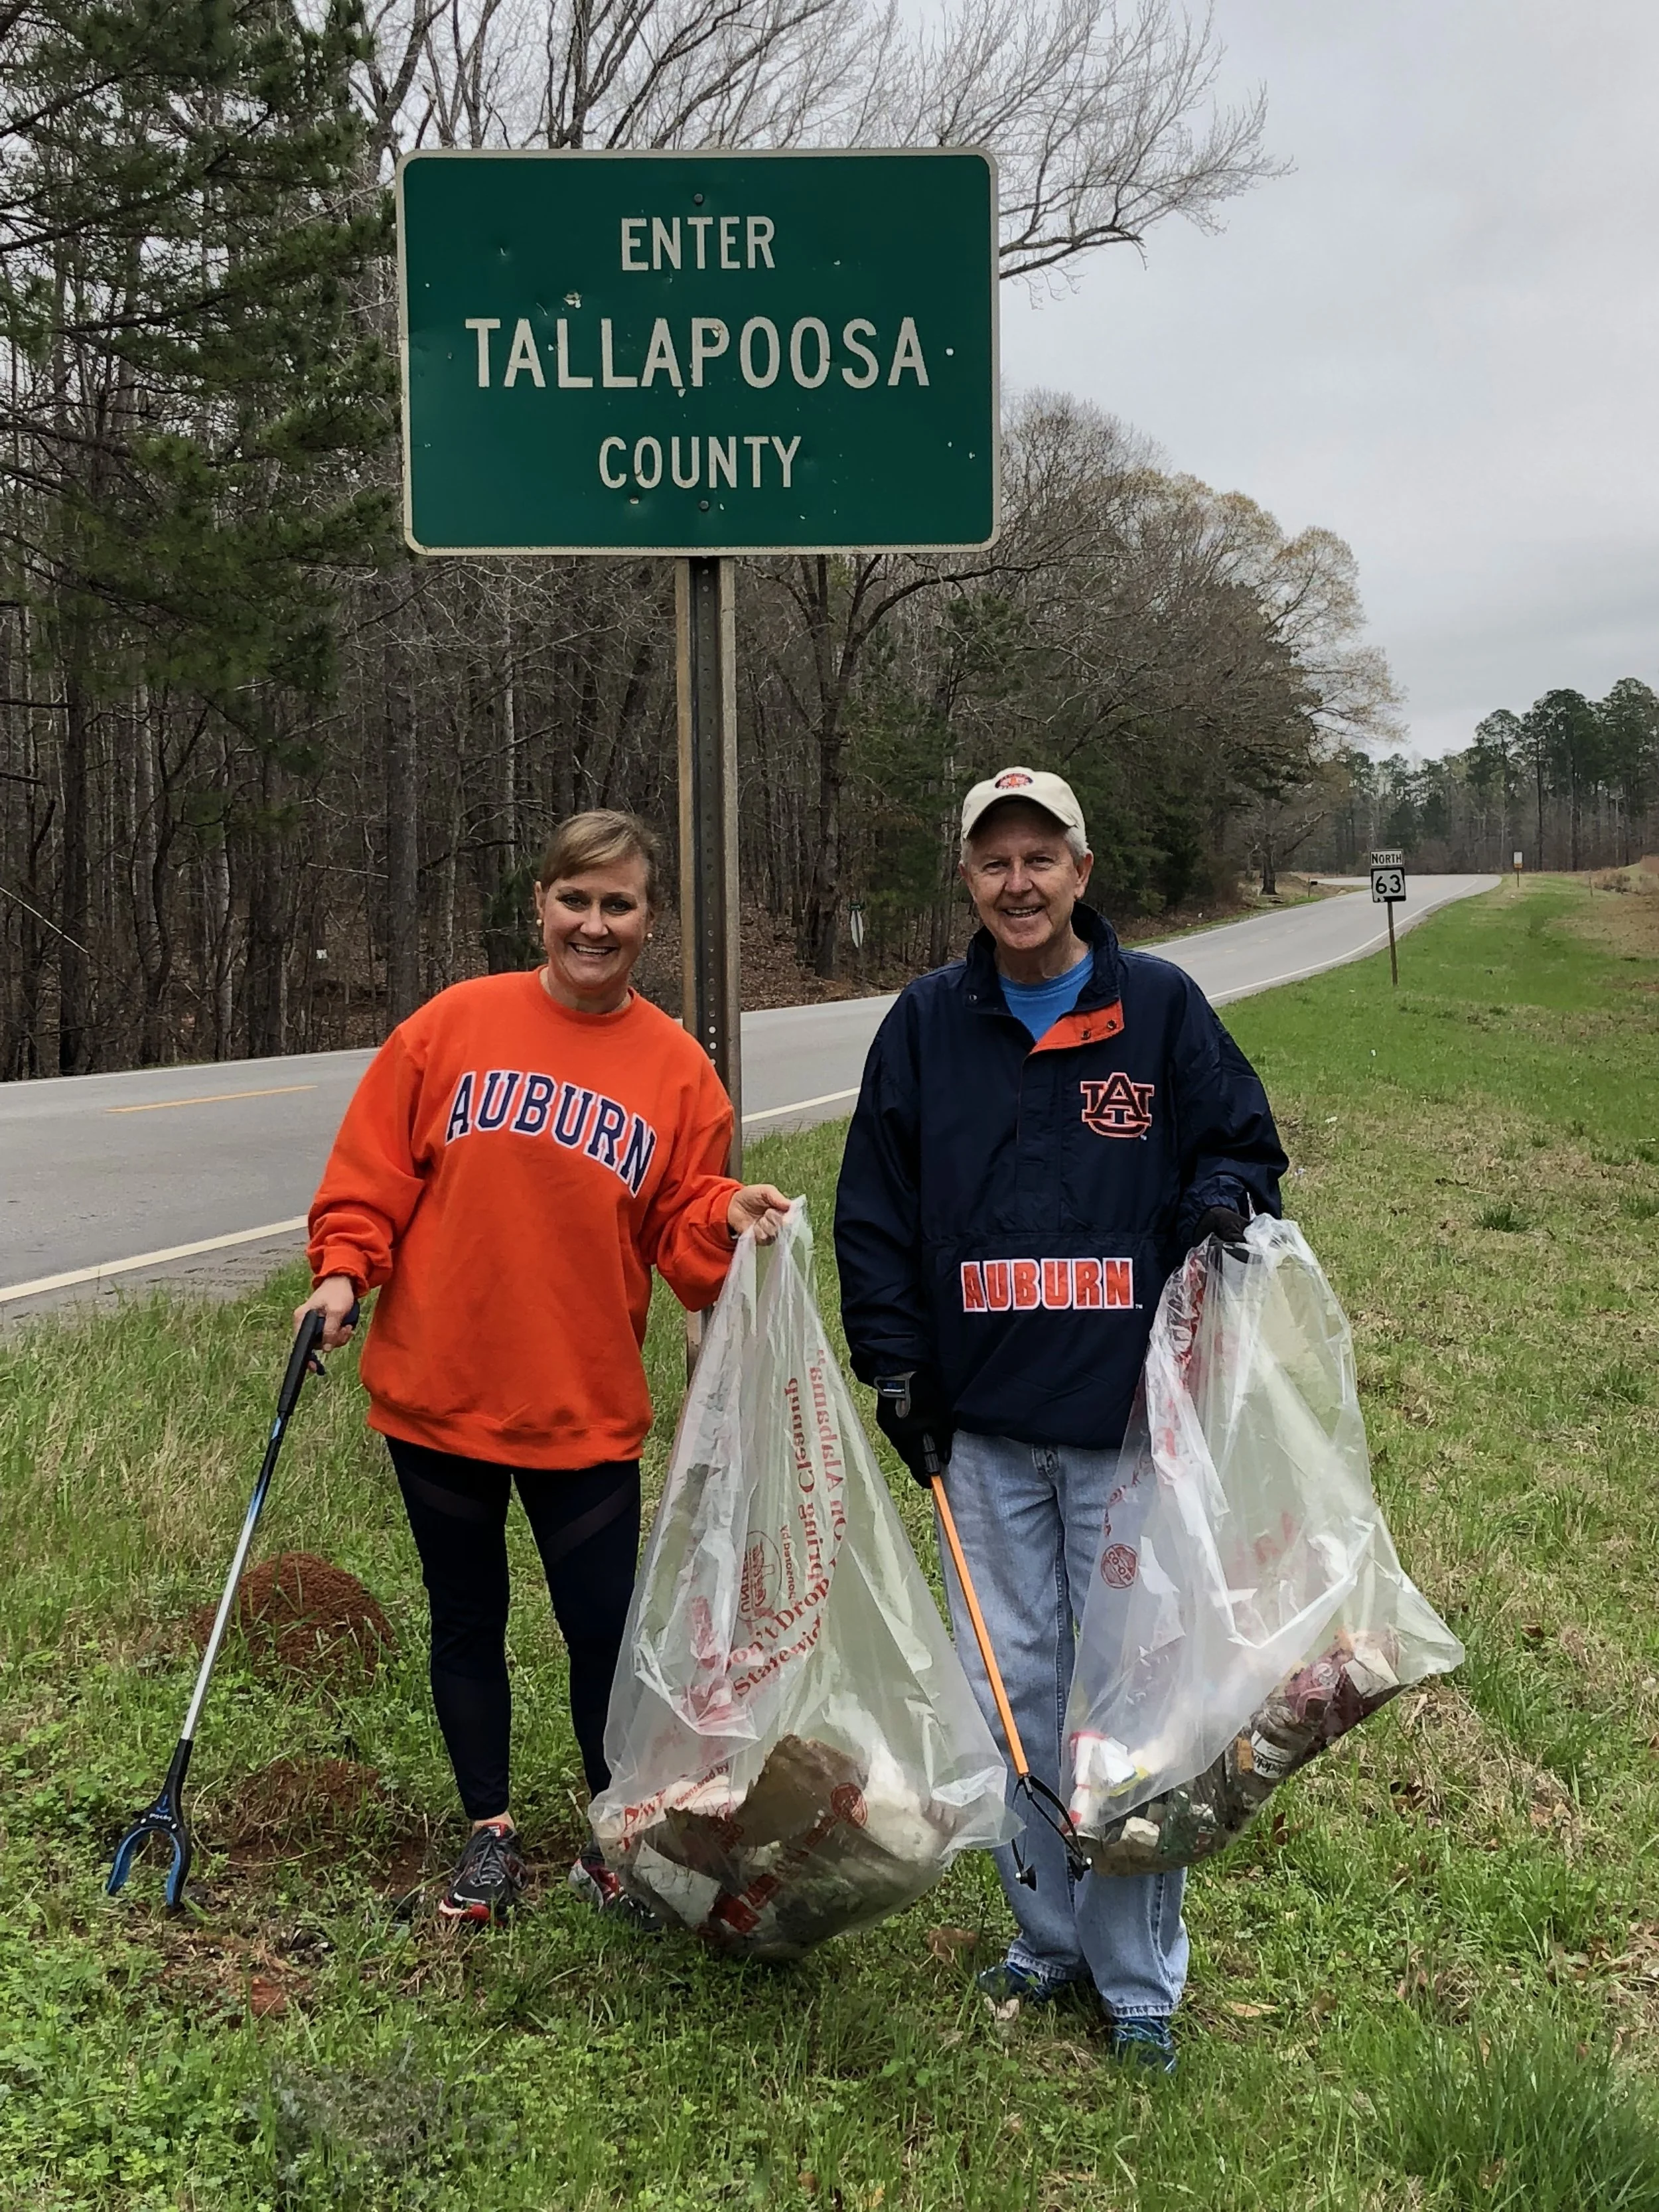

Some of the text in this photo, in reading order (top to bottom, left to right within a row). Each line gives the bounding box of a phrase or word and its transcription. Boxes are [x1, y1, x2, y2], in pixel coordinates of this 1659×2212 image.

[621, 216, 775, 271] ENTER
[465, 317, 930, 389] TALLAPOOSA
[599, 436, 801, 488] COUNTY
[1372, 853, 1402, 864] NORTH
[1376, 874, 1401, 894] 63
[445, 1070, 658, 1199] AUBURN
[961, 1257, 1134, 1312] AUBURN
[1108, 1551, 1132, 1581] CO-OP
[774, 1578, 830, 1631] Drop
[715, 1762, 729, 1775] by
